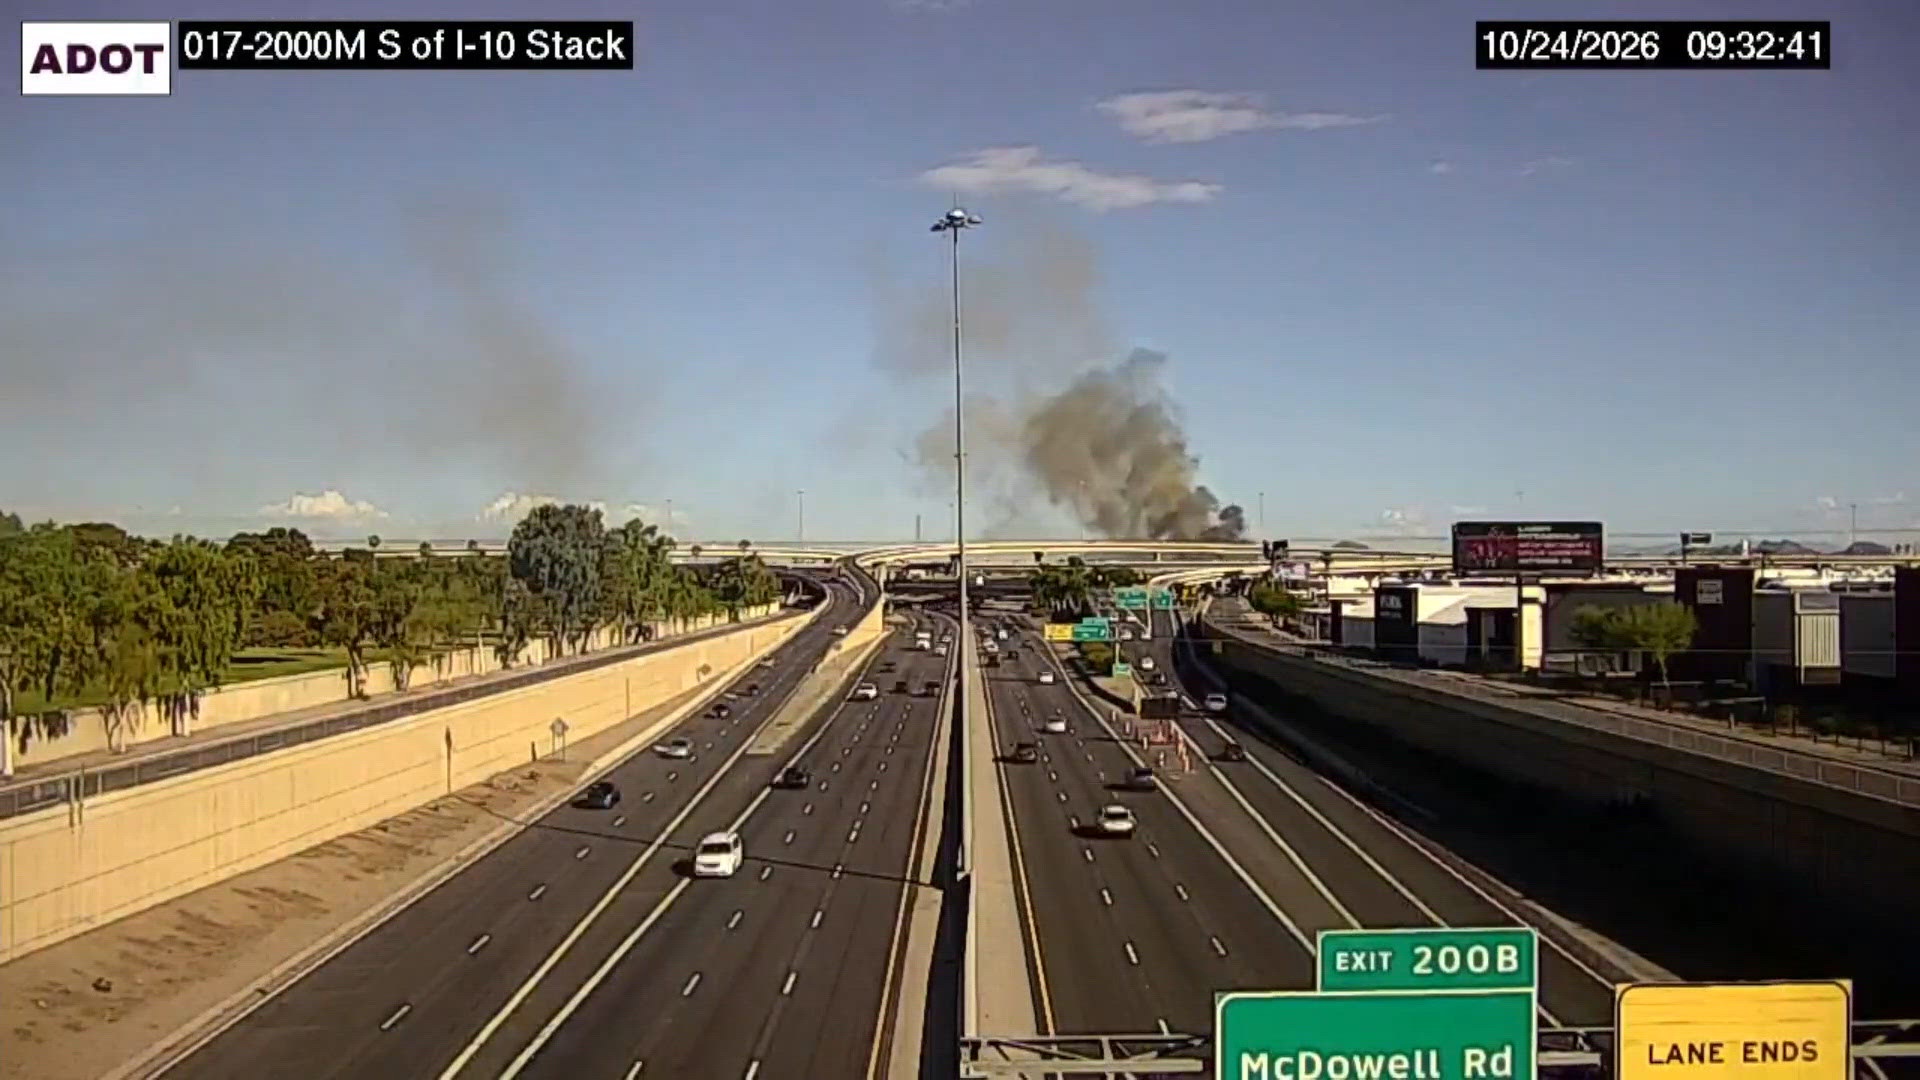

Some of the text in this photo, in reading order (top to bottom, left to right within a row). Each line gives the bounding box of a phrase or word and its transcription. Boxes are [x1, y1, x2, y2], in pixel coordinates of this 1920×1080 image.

[1336, 944, 1518, 974] EXIT 200B
[1241, 1045, 1512, 1080] McDowell Rd
[1648, 1040, 1818, 1065] LANE ENDS
